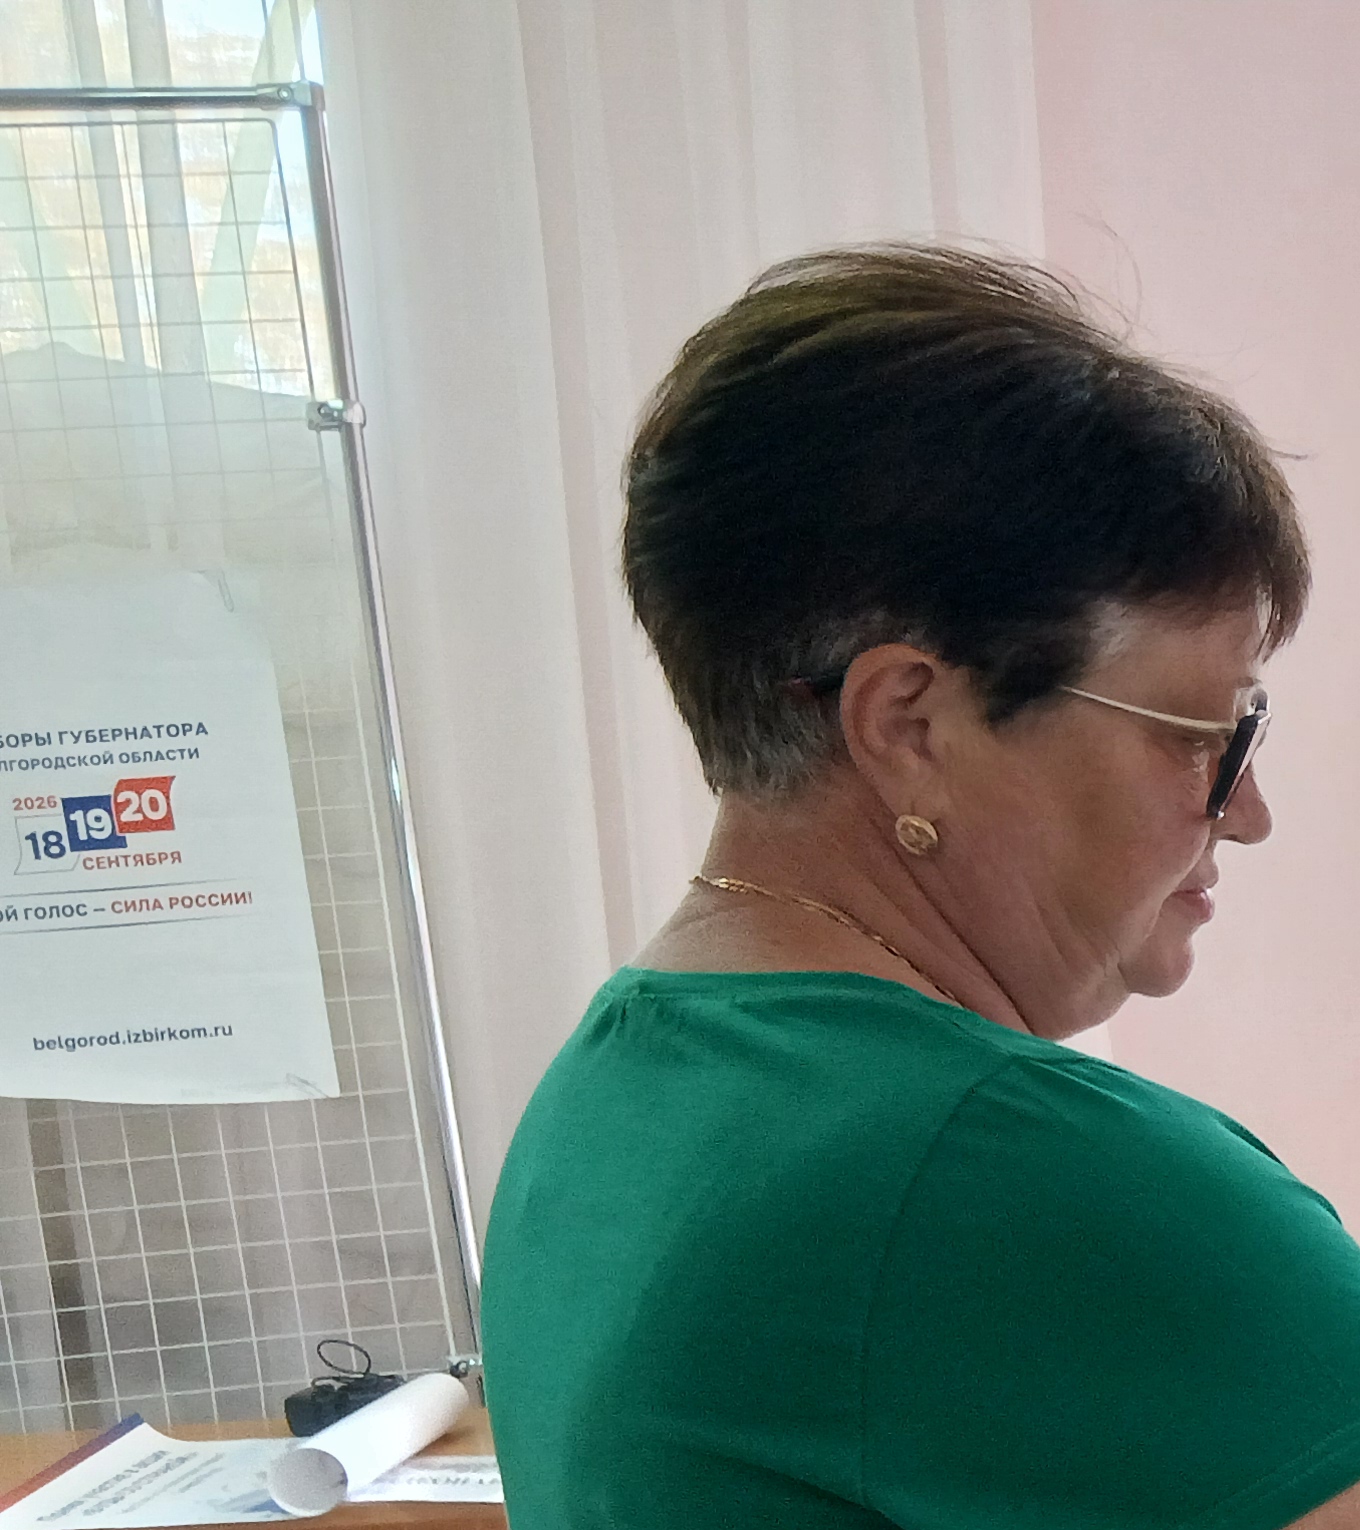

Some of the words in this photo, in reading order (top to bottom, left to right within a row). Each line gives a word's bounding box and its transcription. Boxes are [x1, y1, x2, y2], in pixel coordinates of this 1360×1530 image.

[58, 722, 209, 746] ГУБЕРНАТОРА
[118, 747, 200, 764] ОБЛАСТИ
[12, 795, 58, 811] 2026
[24, 830, 67, 860] 18
[69, 808, 113, 841] 19
[116, 789, 168, 822] 20
[82, 850, 183, 870] СЕНТЯБРЯ
[23, 903, 88, 921] ГОЛОС
[111, 898, 164, 914] СИЛА
[168, 891, 253, 910] РОССИИ!
[33, 1024, 233, 1053] belgorod.izbirkom.ru
